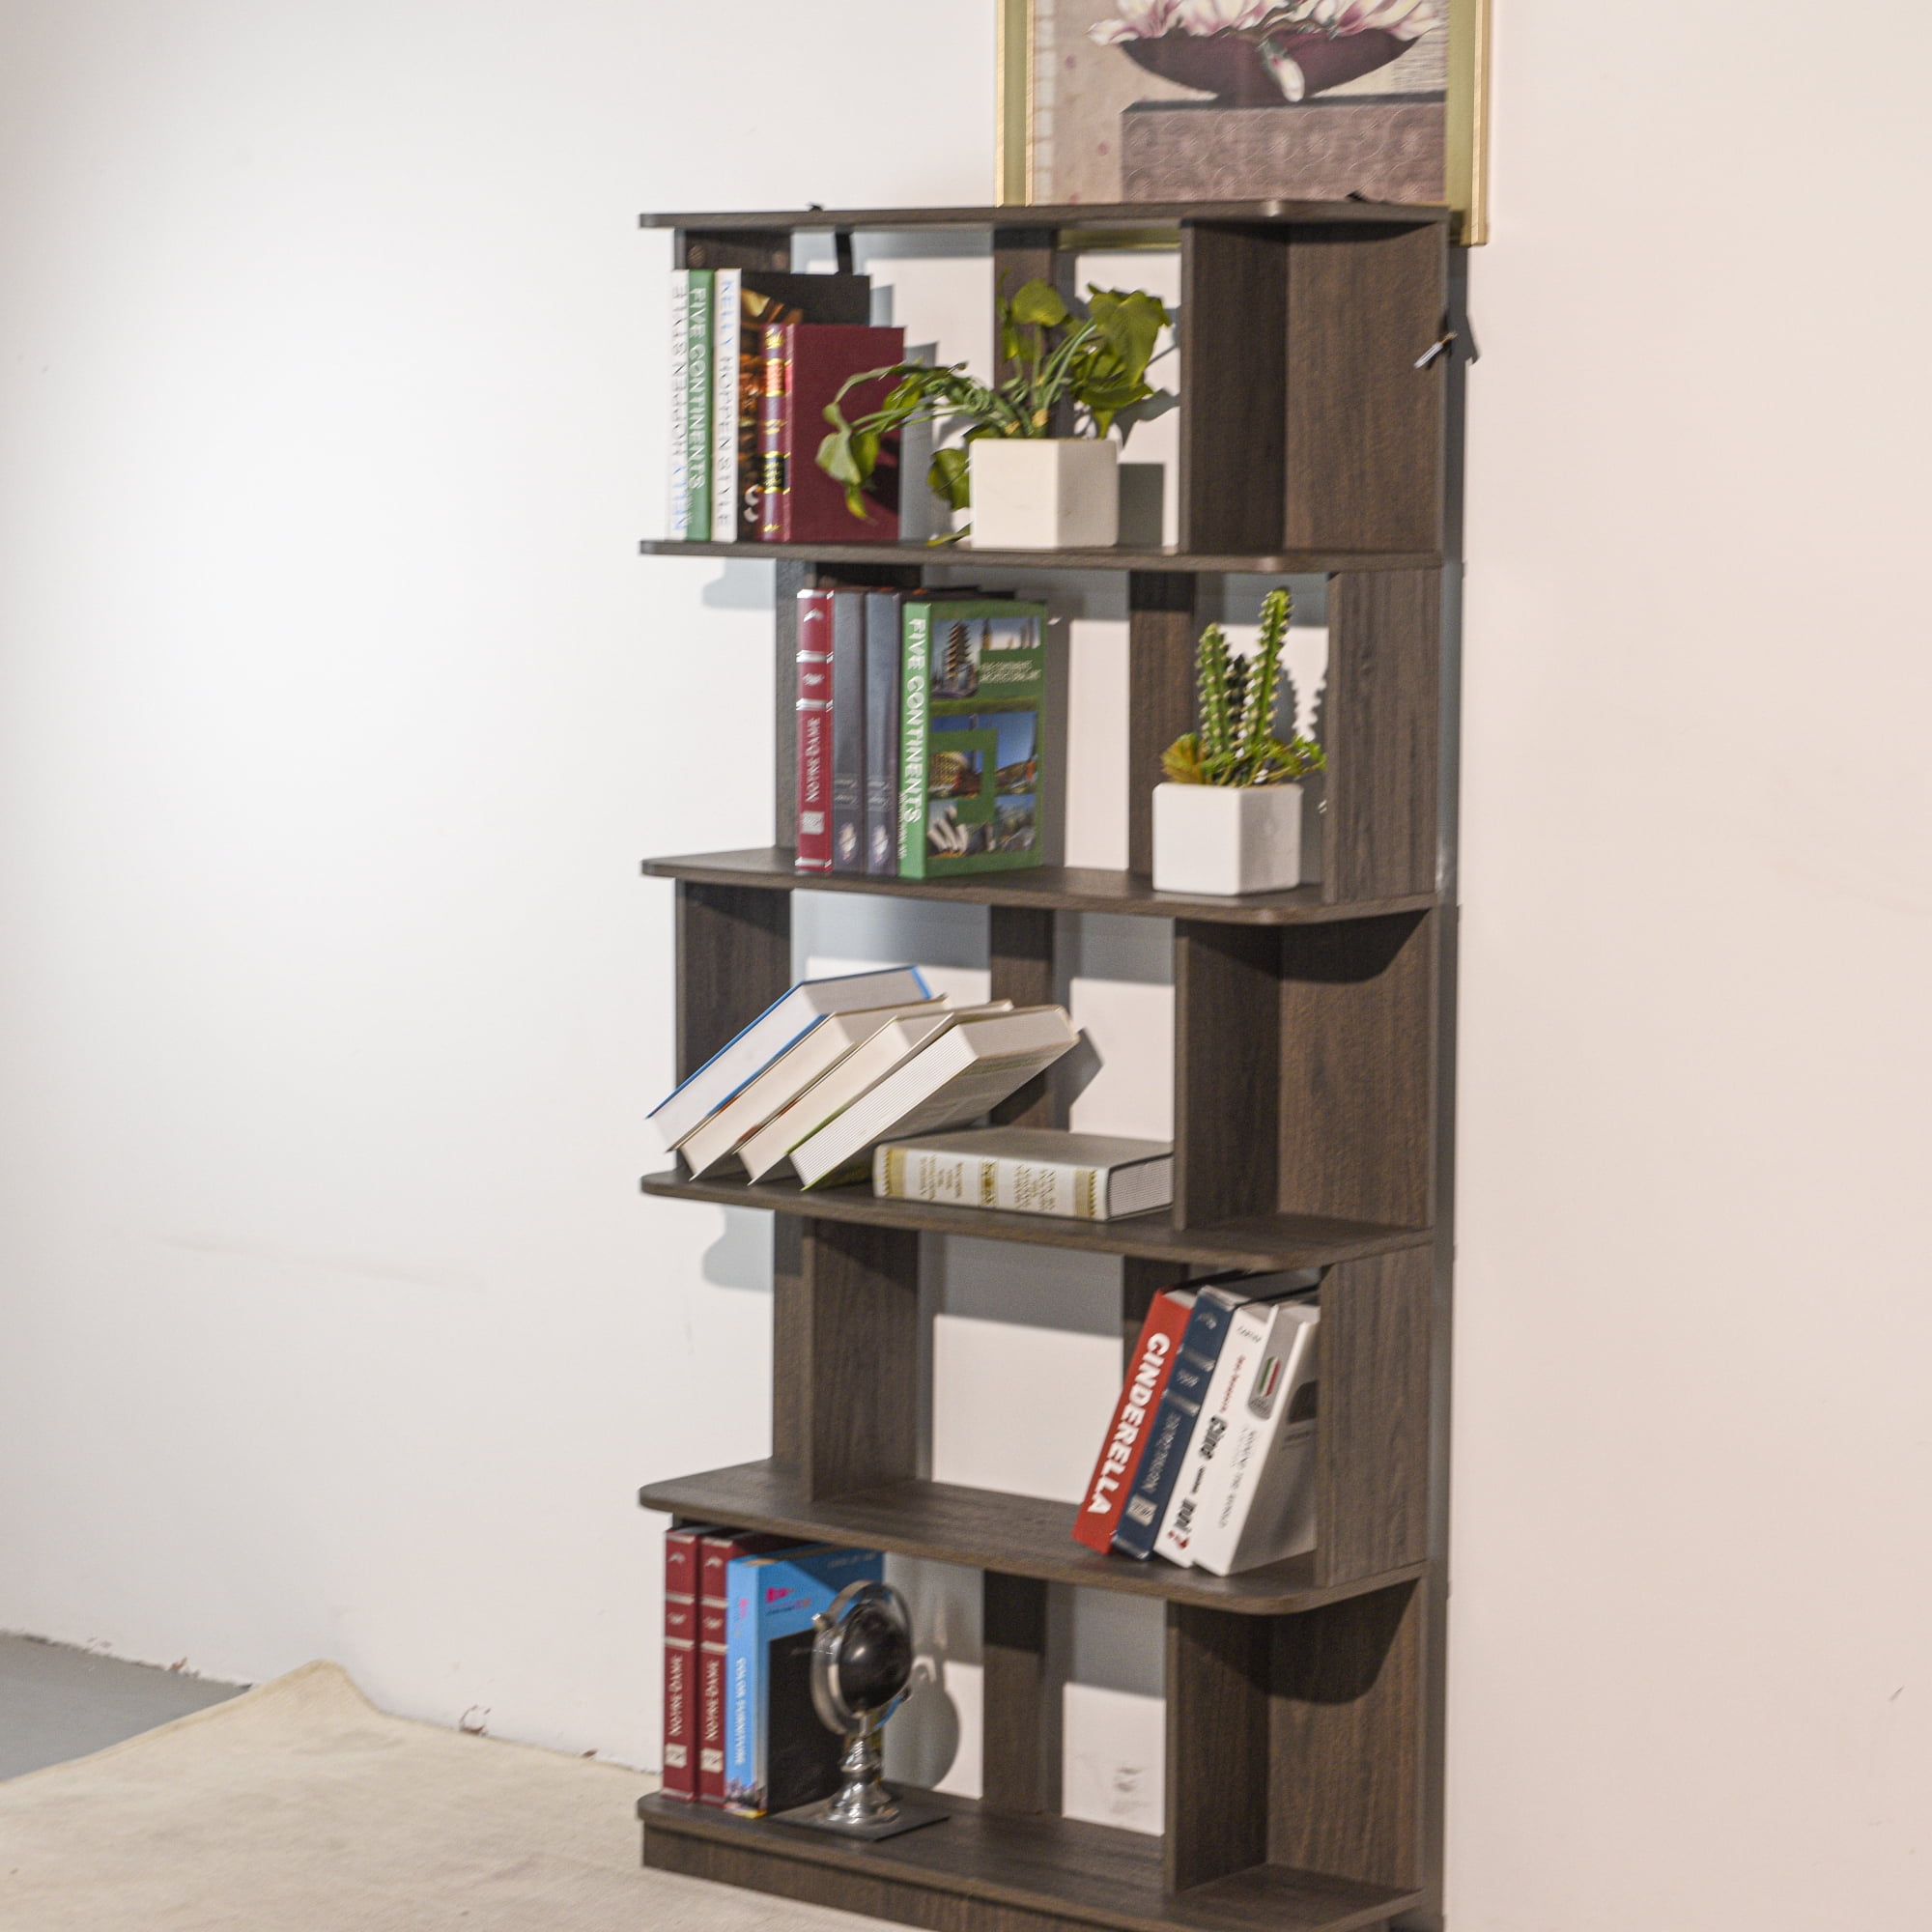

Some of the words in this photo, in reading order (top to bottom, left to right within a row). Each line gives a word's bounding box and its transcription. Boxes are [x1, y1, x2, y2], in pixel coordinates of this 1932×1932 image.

[690, 288, 707, 339] FIVE
[721, 279, 734, 347] KELLY
[689, 344, 706, 489] CONTINENTS
[719, 355, 733, 450] HOPPEN
[718, 457, 731, 526] STYLE
[907, 618, 926, 670] FIVE
[903, 675, 924, 823] CONTINENTS
[1087, 1332, 1171, 1515] CINDERELLA
